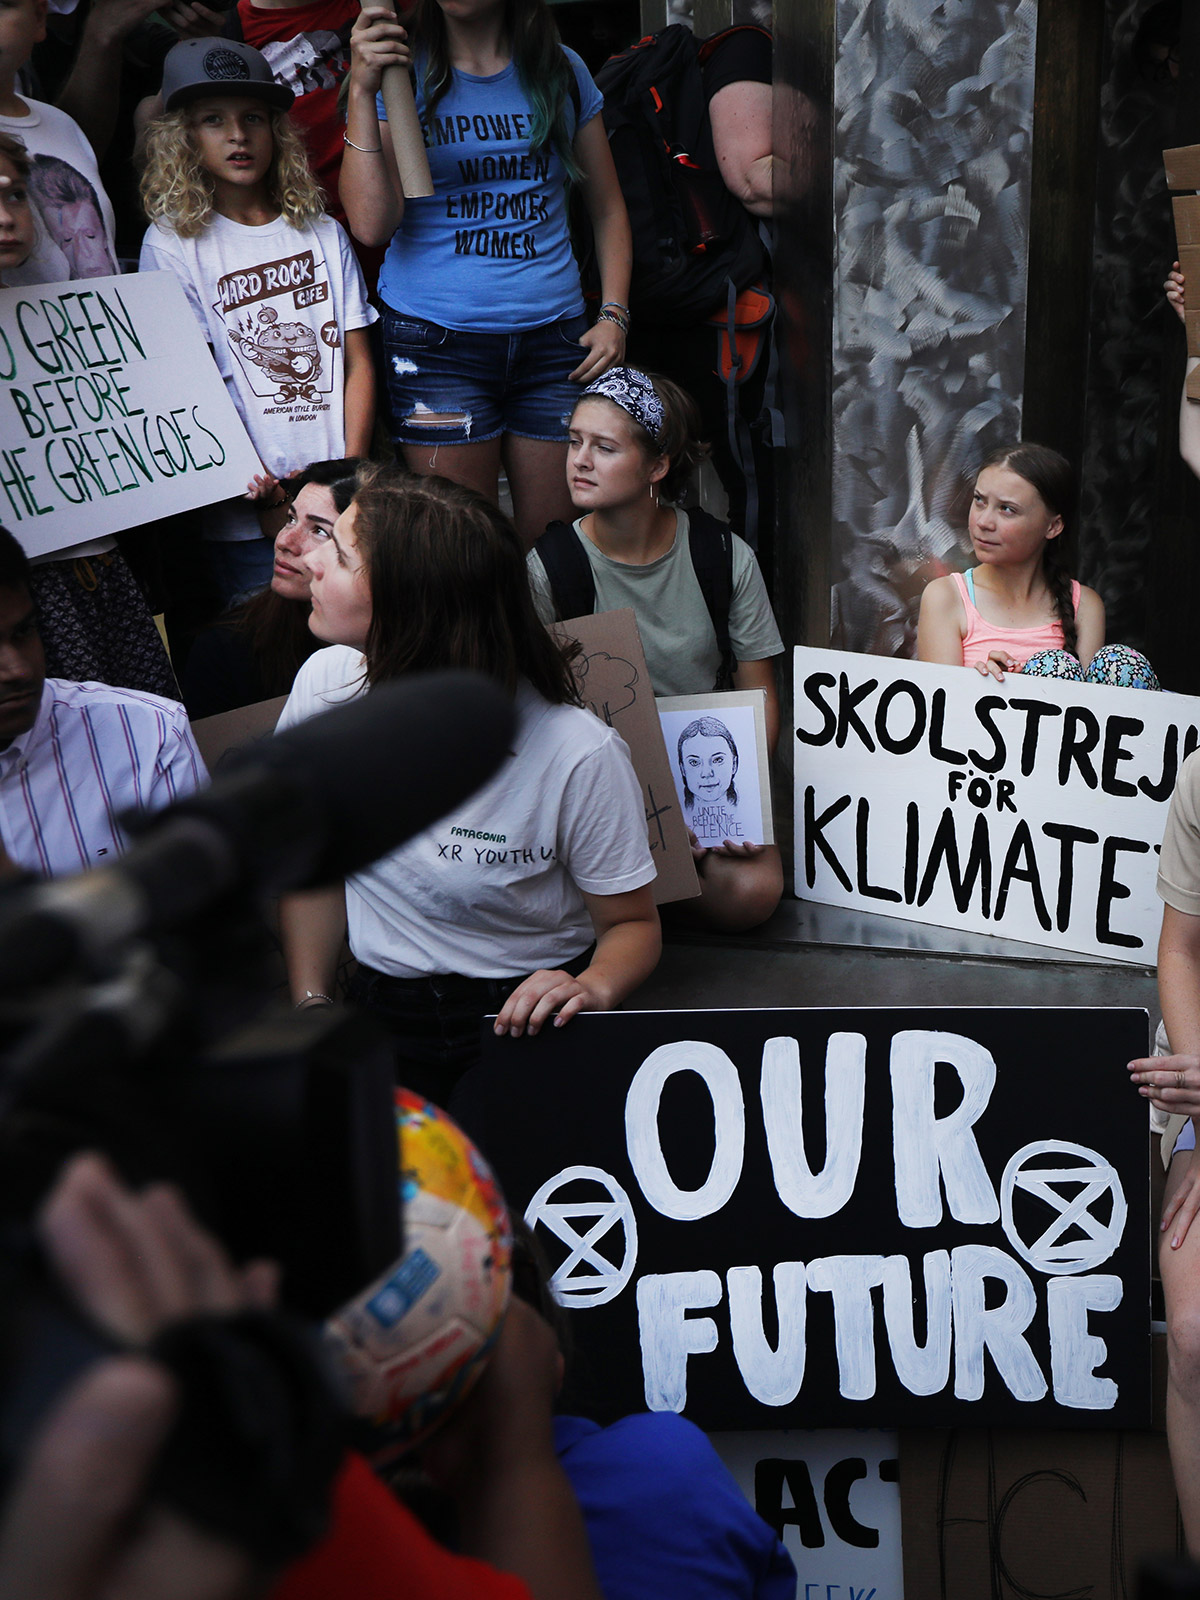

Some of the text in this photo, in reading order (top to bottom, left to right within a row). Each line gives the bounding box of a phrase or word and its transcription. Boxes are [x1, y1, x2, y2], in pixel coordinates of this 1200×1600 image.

[457, 155, 550, 184] WOMEN
[446, 191, 549, 221] EMPOWER
[455, 229, 537, 259] WOMEN
[219, 258, 313, 307] HARD ROCK
[296, 285, 325, 306] CAFE
[15, 287, 147, 374] GREEN
[10, 367, 145, 439] BEFORE
[263, 405, 293, 415] AMERICAN
[294, 404, 310, 413] STYLE
[295, 414, 317, 422] LONDON
[0, 405, 226, 523] HE GREEN GOES
[948, 769, 1017, 813] FÖR
[692, 814, 723, 827] BEHIND
[697, 805, 727, 817] UNITE
[450, 826, 507, 844] PATAGONIA
[688, 822, 745, 839] CIENCE
[438, 843, 463, 862] XR
[473, 847, 535, 865] YOUTH
[804, 785, 1161, 948] KLIMATE
[624, 1030, 1001, 1229] OUR
[637, 1244, 1124, 1414] FUTURE
